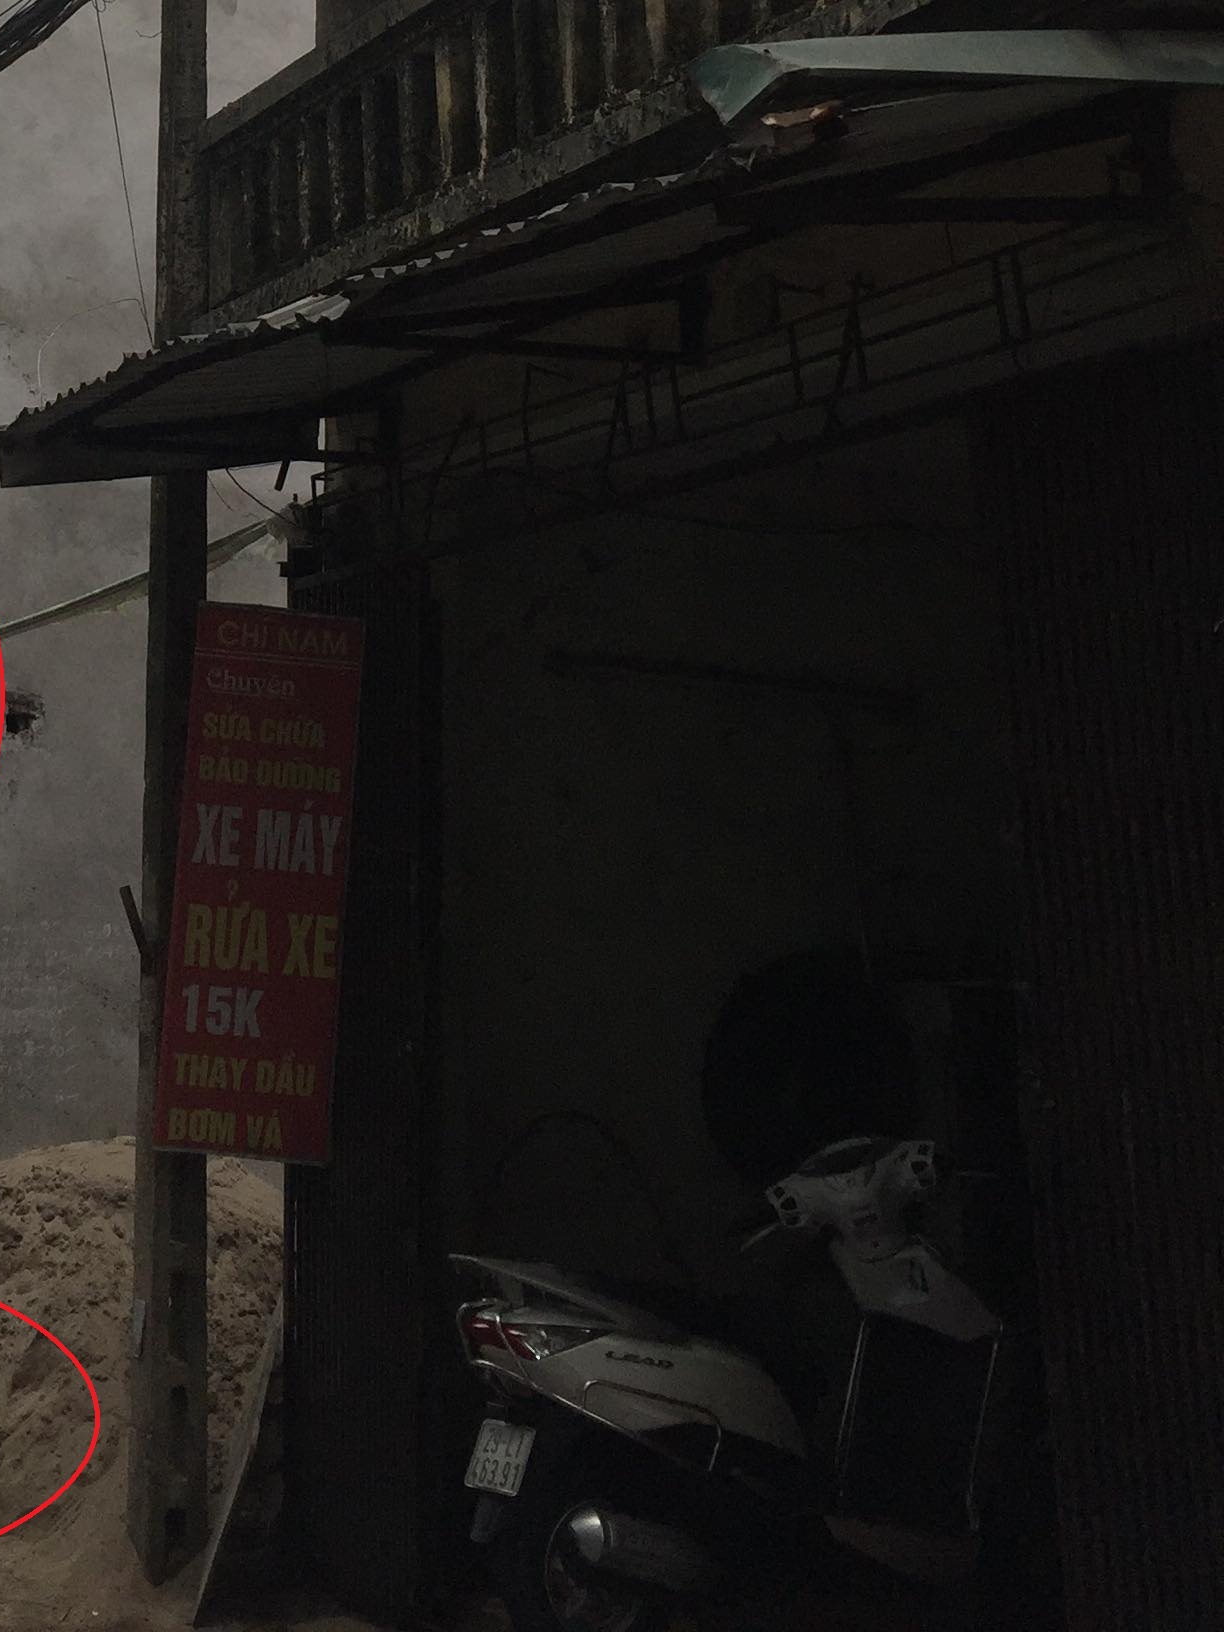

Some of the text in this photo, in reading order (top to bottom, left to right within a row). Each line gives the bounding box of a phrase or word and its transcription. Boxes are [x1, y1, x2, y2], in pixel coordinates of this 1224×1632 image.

[277, 625, 347, 656] NAM
[206, 667, 296, 698] Chuyên
[201, 704, 253, 742] SỬA
[198, 746, 249, 785] BẢO
[191, 799, 344, 876] XE MÁY
[183, 879, 339, 980] RỬA XE
[182, 984, 265, 1038] 15K
[173, 1049, 316, 1097] THAY DẦU
[167, 1107, 283, 1150] BƠM VÁ
[605, 1350, 674, 1369] LEAD
